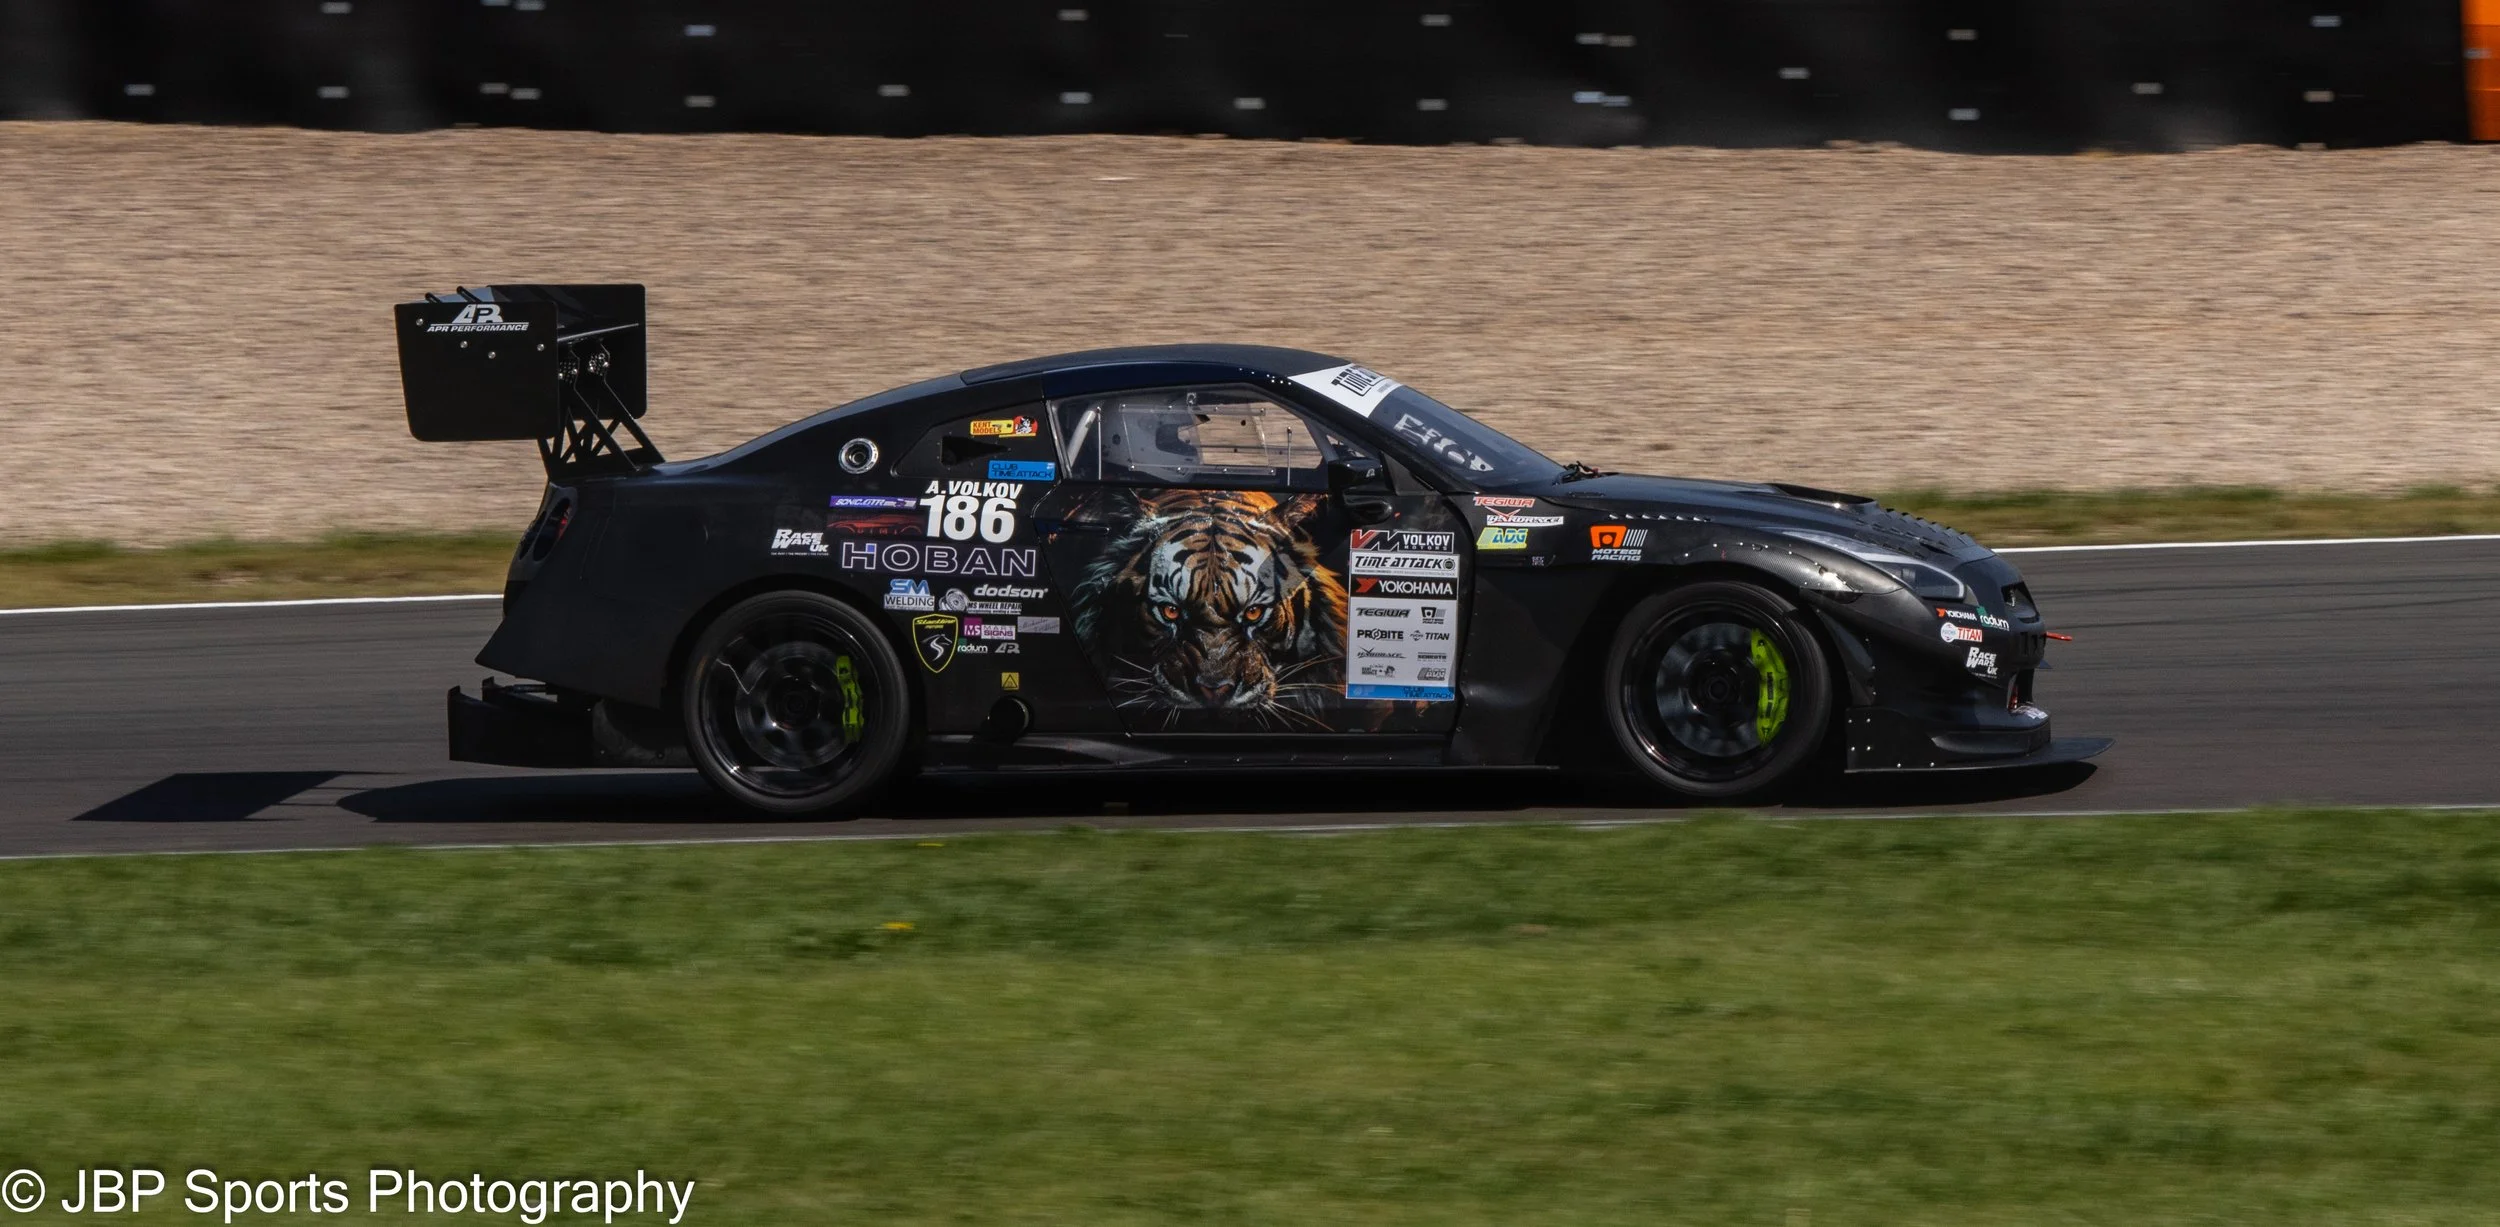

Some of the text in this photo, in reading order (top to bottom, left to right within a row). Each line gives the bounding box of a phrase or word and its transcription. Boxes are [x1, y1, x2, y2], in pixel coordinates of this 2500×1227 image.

[427, 324, 529, 333] APR PERFORMANCE
[991, 463, 1017, 471] CLUB
[993, 470, 1053, 478] TIME ATTACK
[925, 480, 1023, 500] A.VOLKOV
[1473, 496, 1535, 507] TEGIWA
[920, 495, 1017, 543] 186
[775, 529, 823, 540] RACE
[1403, 534, 1450, 546] VOLKOV
[771, 538, 821, 549] WARS
[810, 544, 829, 552] UK
[842, 542, 1036, 577] HOBAN
[889, 579, 930, 595] SM
[974, 584, 1044, 599] dodson
[1379, 580, 1453, 595] YOKOHAMA
[885, 596, 934, 607] WELDING
[1356, 608, 1411, 618] TEGIWA
[1945, 610, 1977, 621] YOKOHAMA
[1980, 614, 2009, 629] radium
[1425, 632, 1450, 640] TITAN
[1958, 628, 1982, 641] TITAN
[957, 643, 988, 653] radium
[1970, 647, 1996, 661] RACE
[1966, 657, 1995, 668] WARS
[1987, 666, 1998, 675] UK
